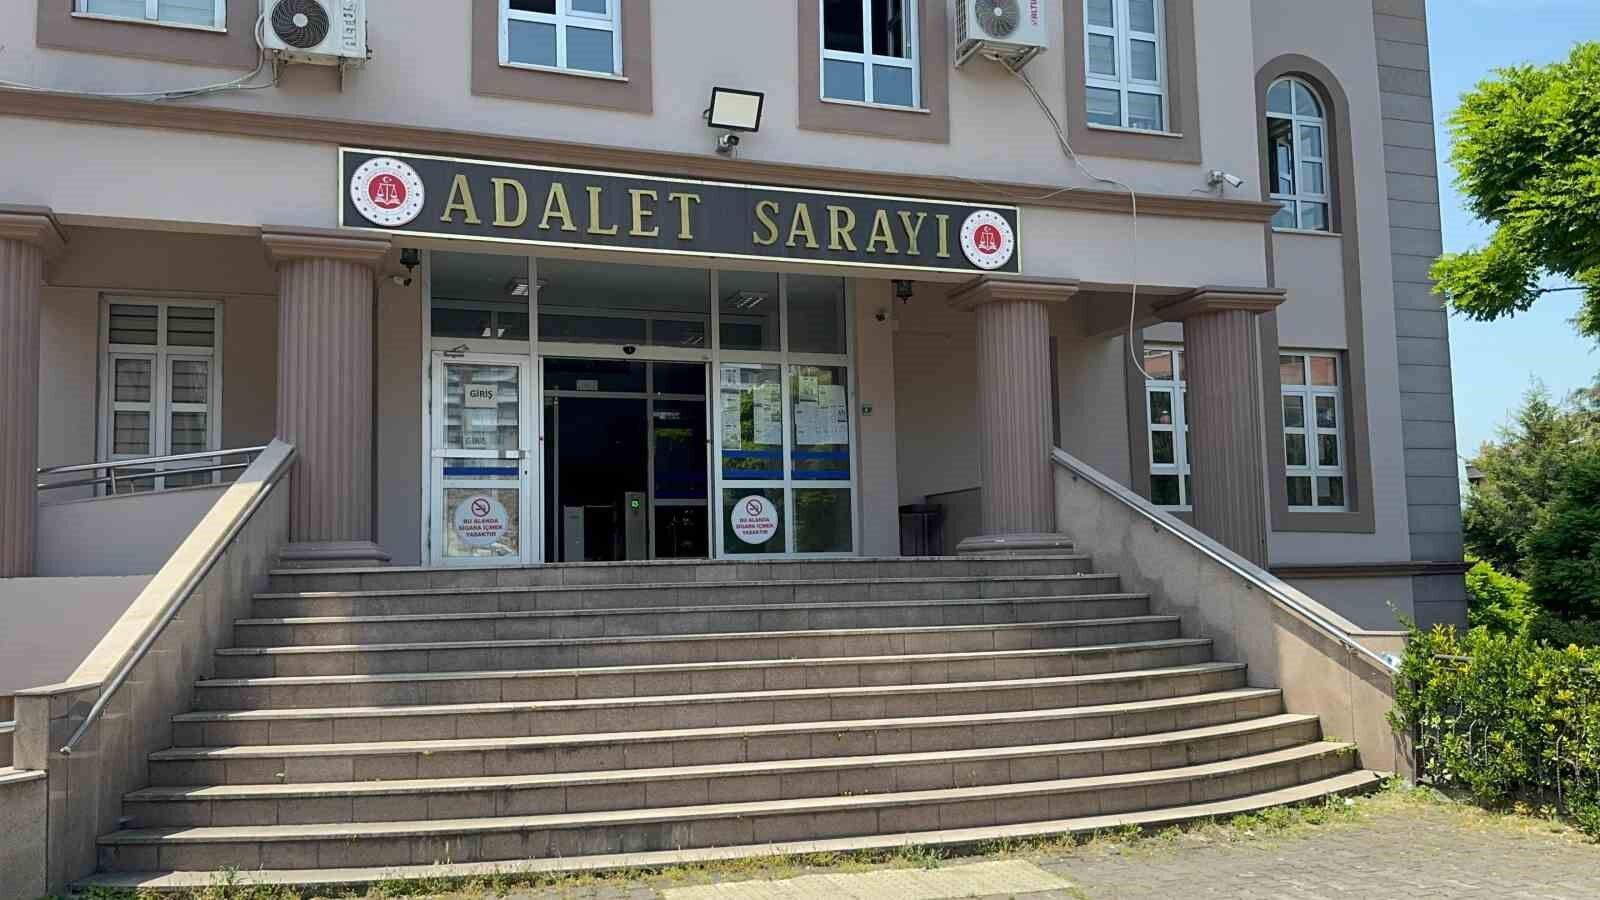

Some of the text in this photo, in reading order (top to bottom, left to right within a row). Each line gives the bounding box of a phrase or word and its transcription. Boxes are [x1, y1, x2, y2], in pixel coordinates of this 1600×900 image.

[440, 174, 701, 240] ADALET
[752, 200, 951, 258] SARAYI
[470, 388, 493, 400] GİRİŞ
